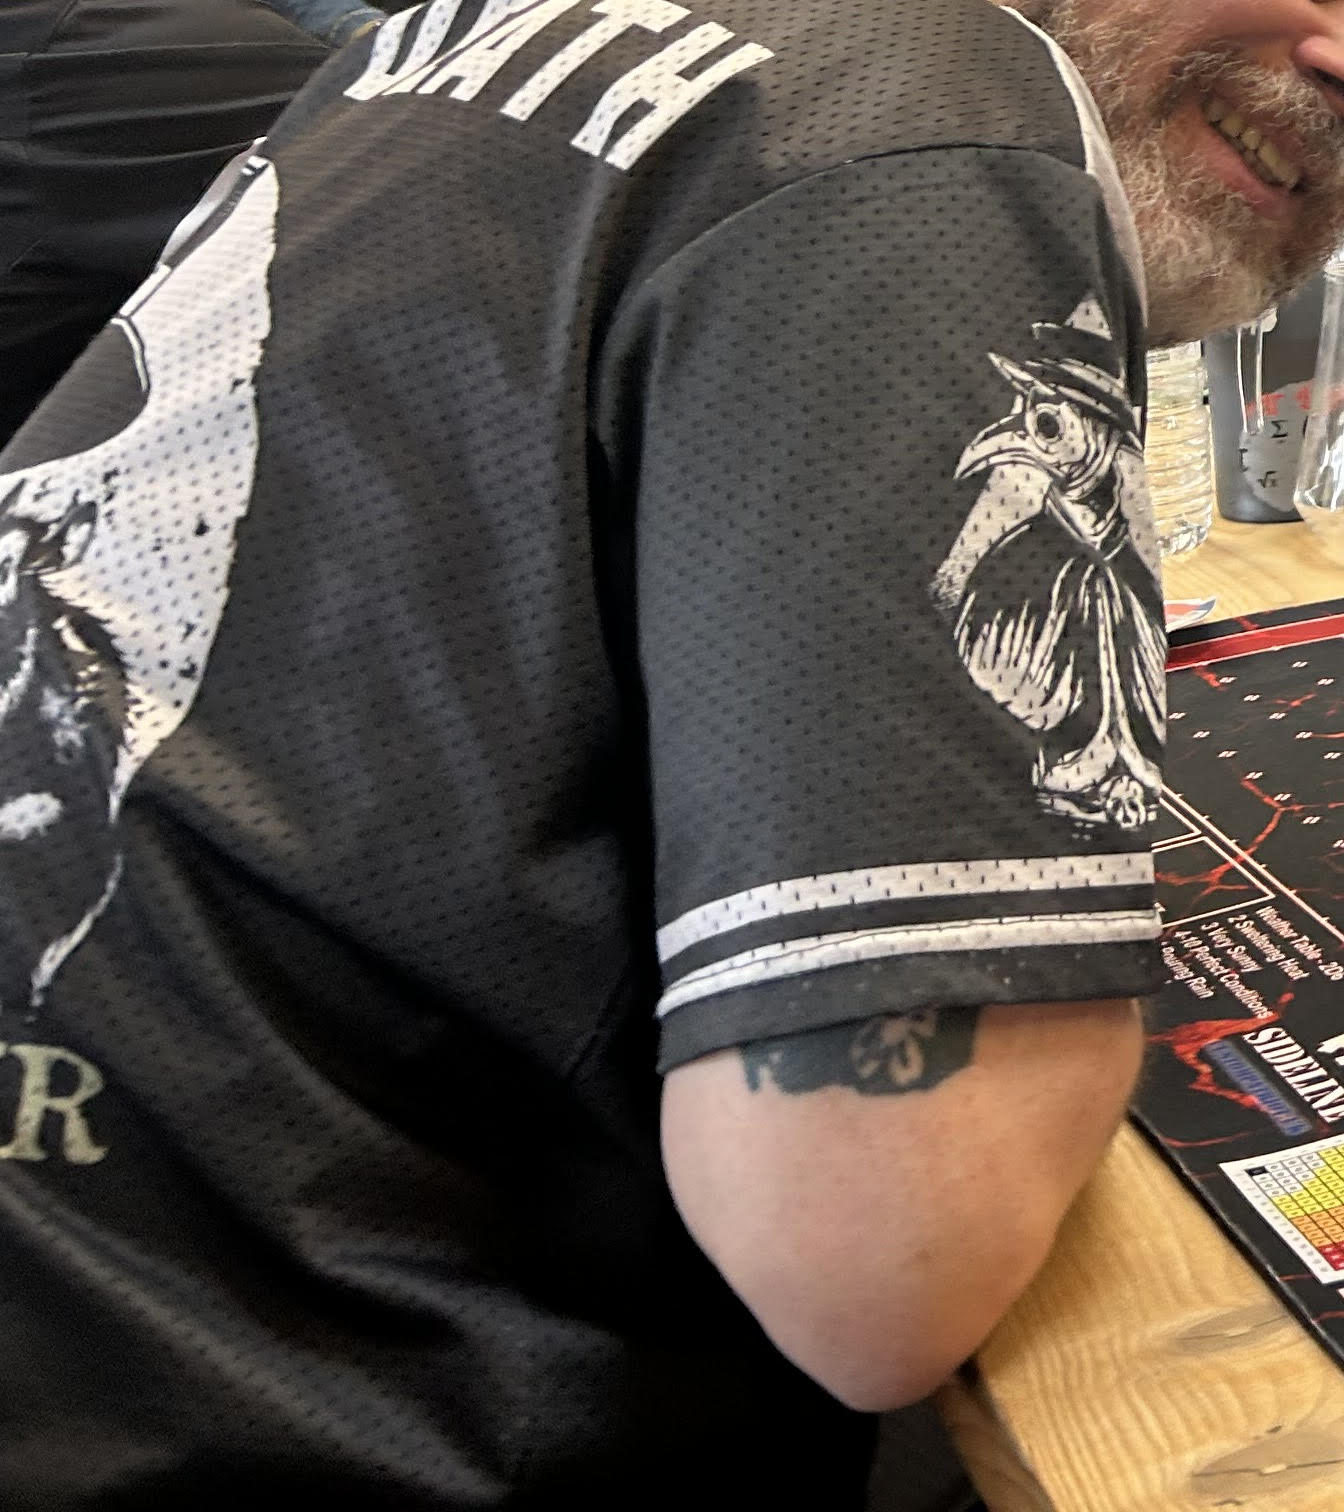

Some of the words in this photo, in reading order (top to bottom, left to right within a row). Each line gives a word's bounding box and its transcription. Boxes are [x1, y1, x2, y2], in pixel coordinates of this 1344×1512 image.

[1208, 927, 1236, 948] Very
[1227, 946, 1263, 973] Sunny
[1235, 920, 1286, 962] Sweltering
[1277, 958, 1310, 981] Heat
[1256, 906, 1298, 939] Weather
[1290, 935, 1323, 960] Table
[1185, 977, 1215, 999] Rain
[1190, 946, 1232, 976] Perfect
[1220, 974, 1275, 1020] Conditions
